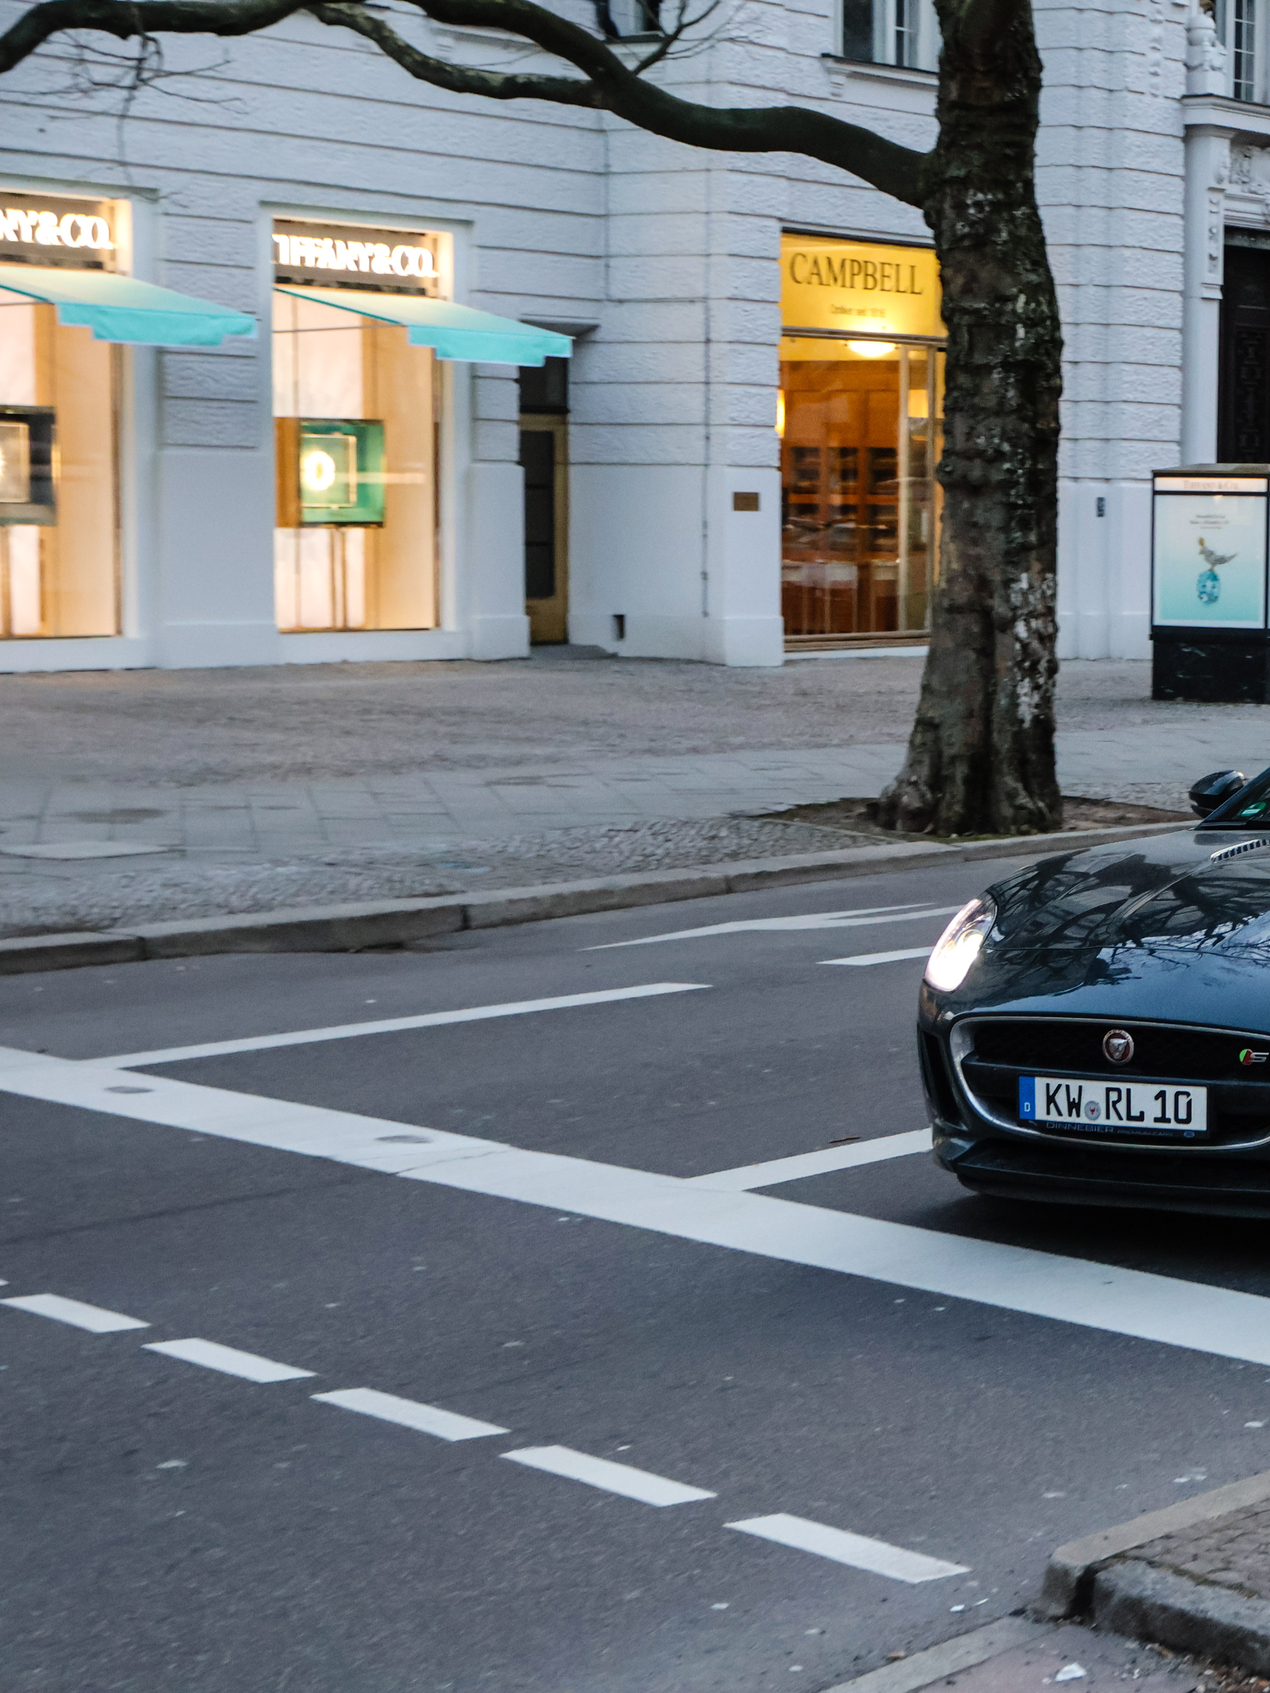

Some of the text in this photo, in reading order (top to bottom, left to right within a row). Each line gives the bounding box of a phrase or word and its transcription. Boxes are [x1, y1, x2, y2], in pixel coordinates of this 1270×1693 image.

[789, 252, 924, 295] CAMPBELL
[1024, 1102, 1031, 1112] D
[1045, 1082, 1192, 1125] KW RL 10
[1046, 1122, 1115, 1134] DINNEBIER
